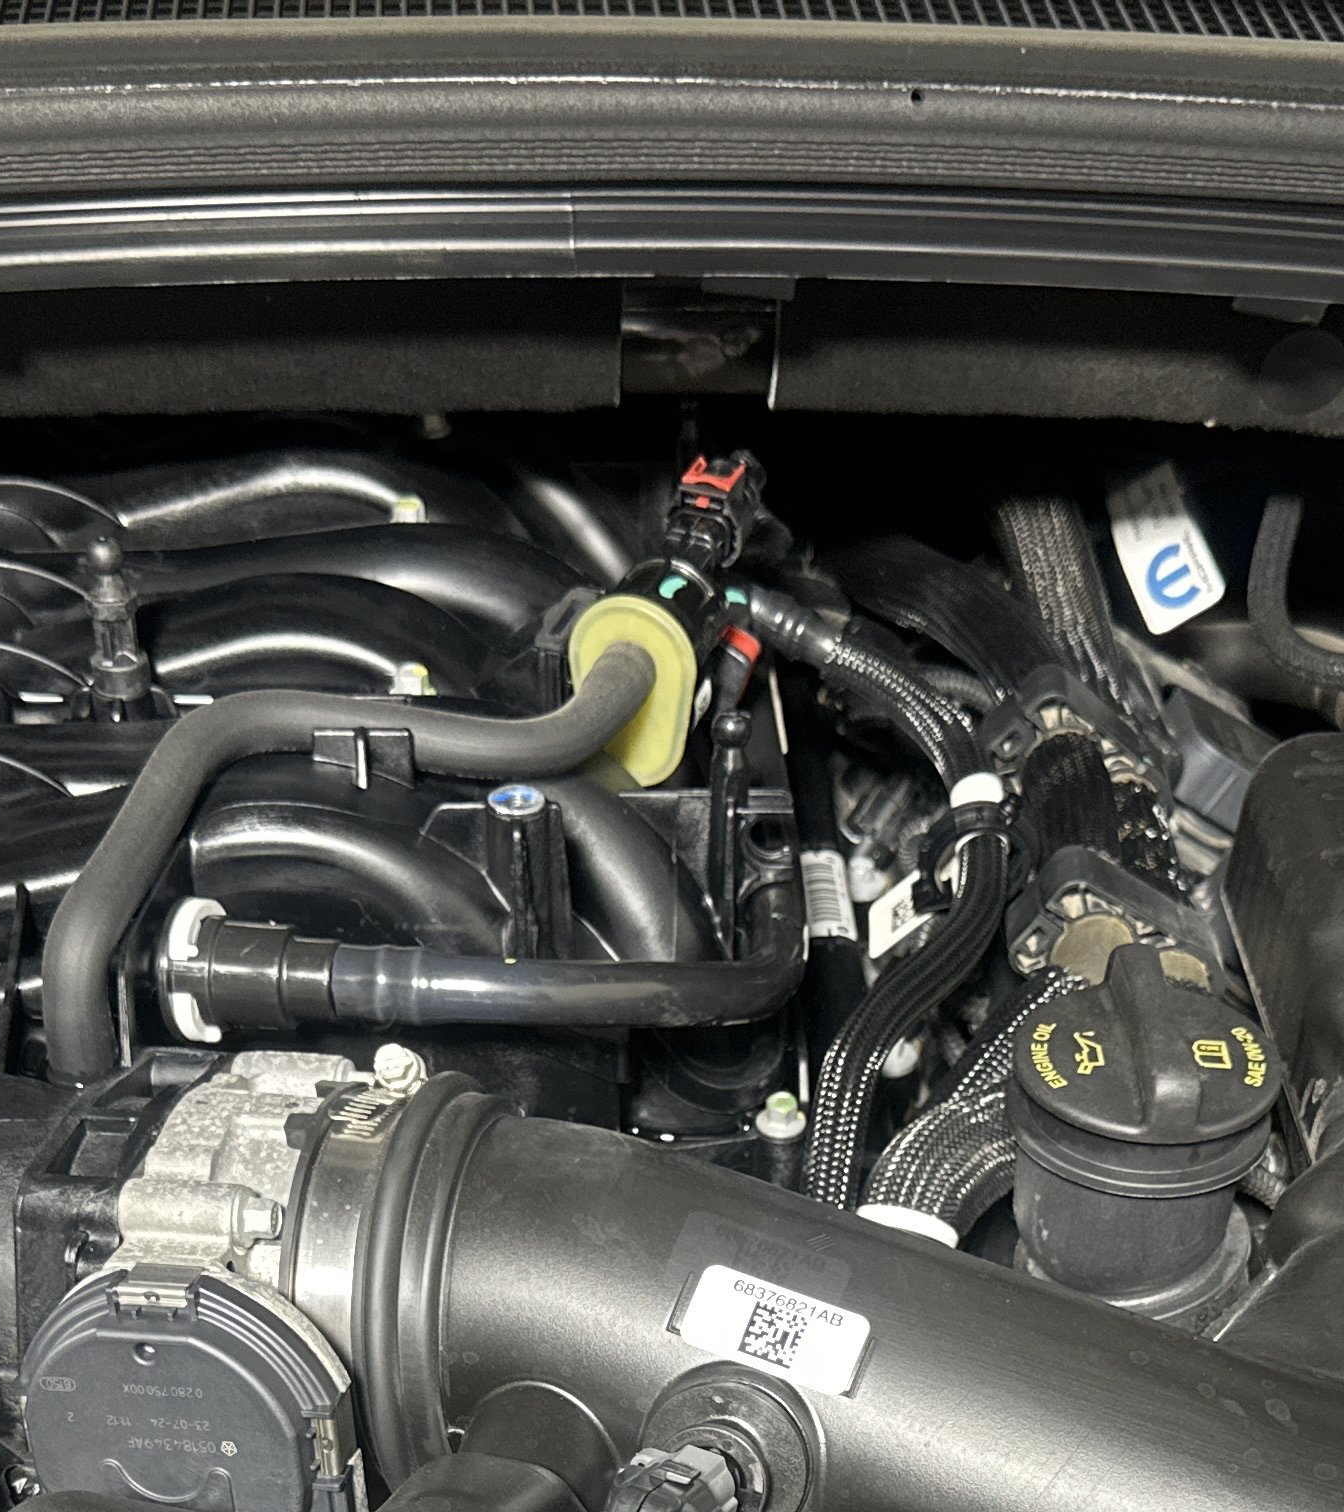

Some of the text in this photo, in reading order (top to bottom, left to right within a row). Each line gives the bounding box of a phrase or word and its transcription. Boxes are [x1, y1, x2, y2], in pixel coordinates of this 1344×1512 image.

[1030, 1022, 1069, 1089] ENGINE OIL
[1243, 1061, 1267, 1088] SAE
[732, 1279, 845, 1328] 68376821AB
[149, 1417, 211, 1431] 23-07-24
